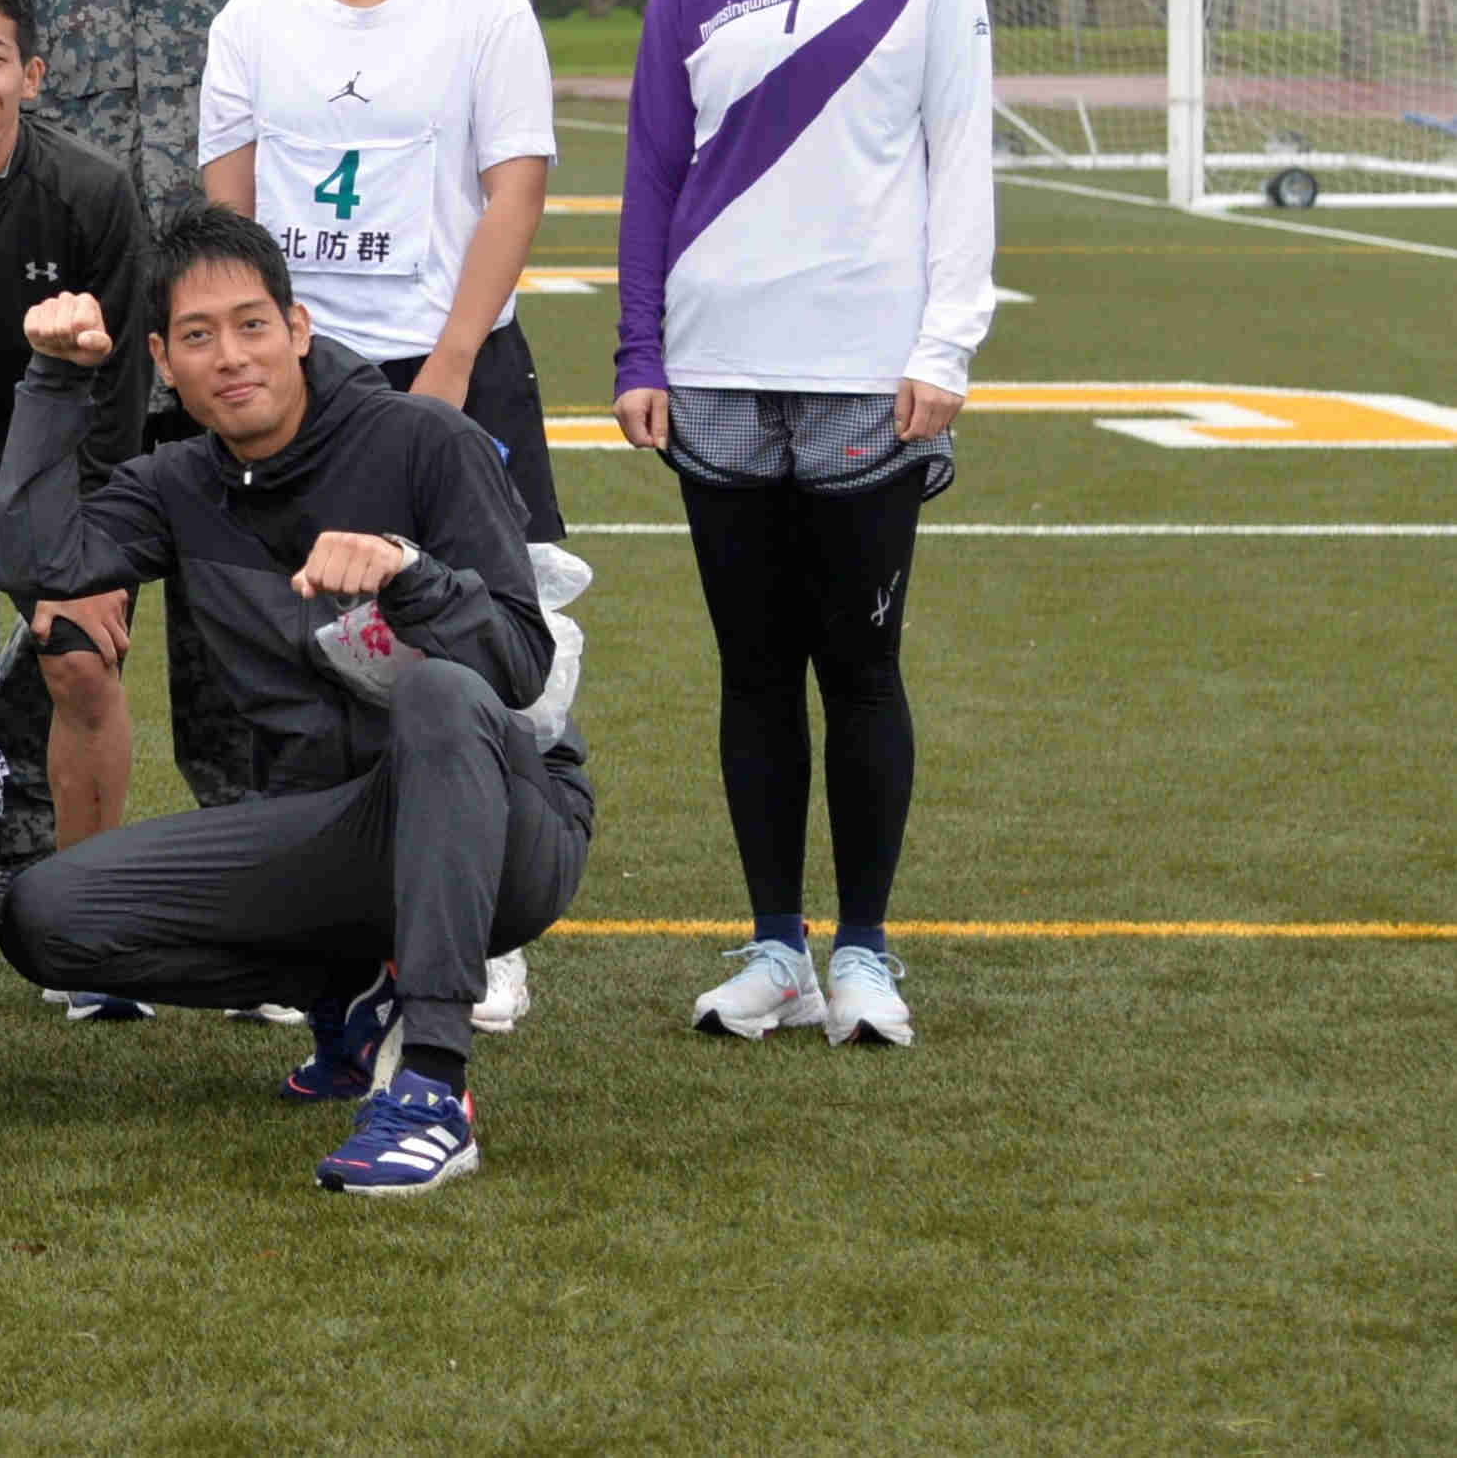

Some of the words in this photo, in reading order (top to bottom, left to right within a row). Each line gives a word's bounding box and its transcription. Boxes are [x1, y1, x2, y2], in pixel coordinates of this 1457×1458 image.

[314, 149, 360, 220] 4
[280, 226, 390, 262] 北防群
